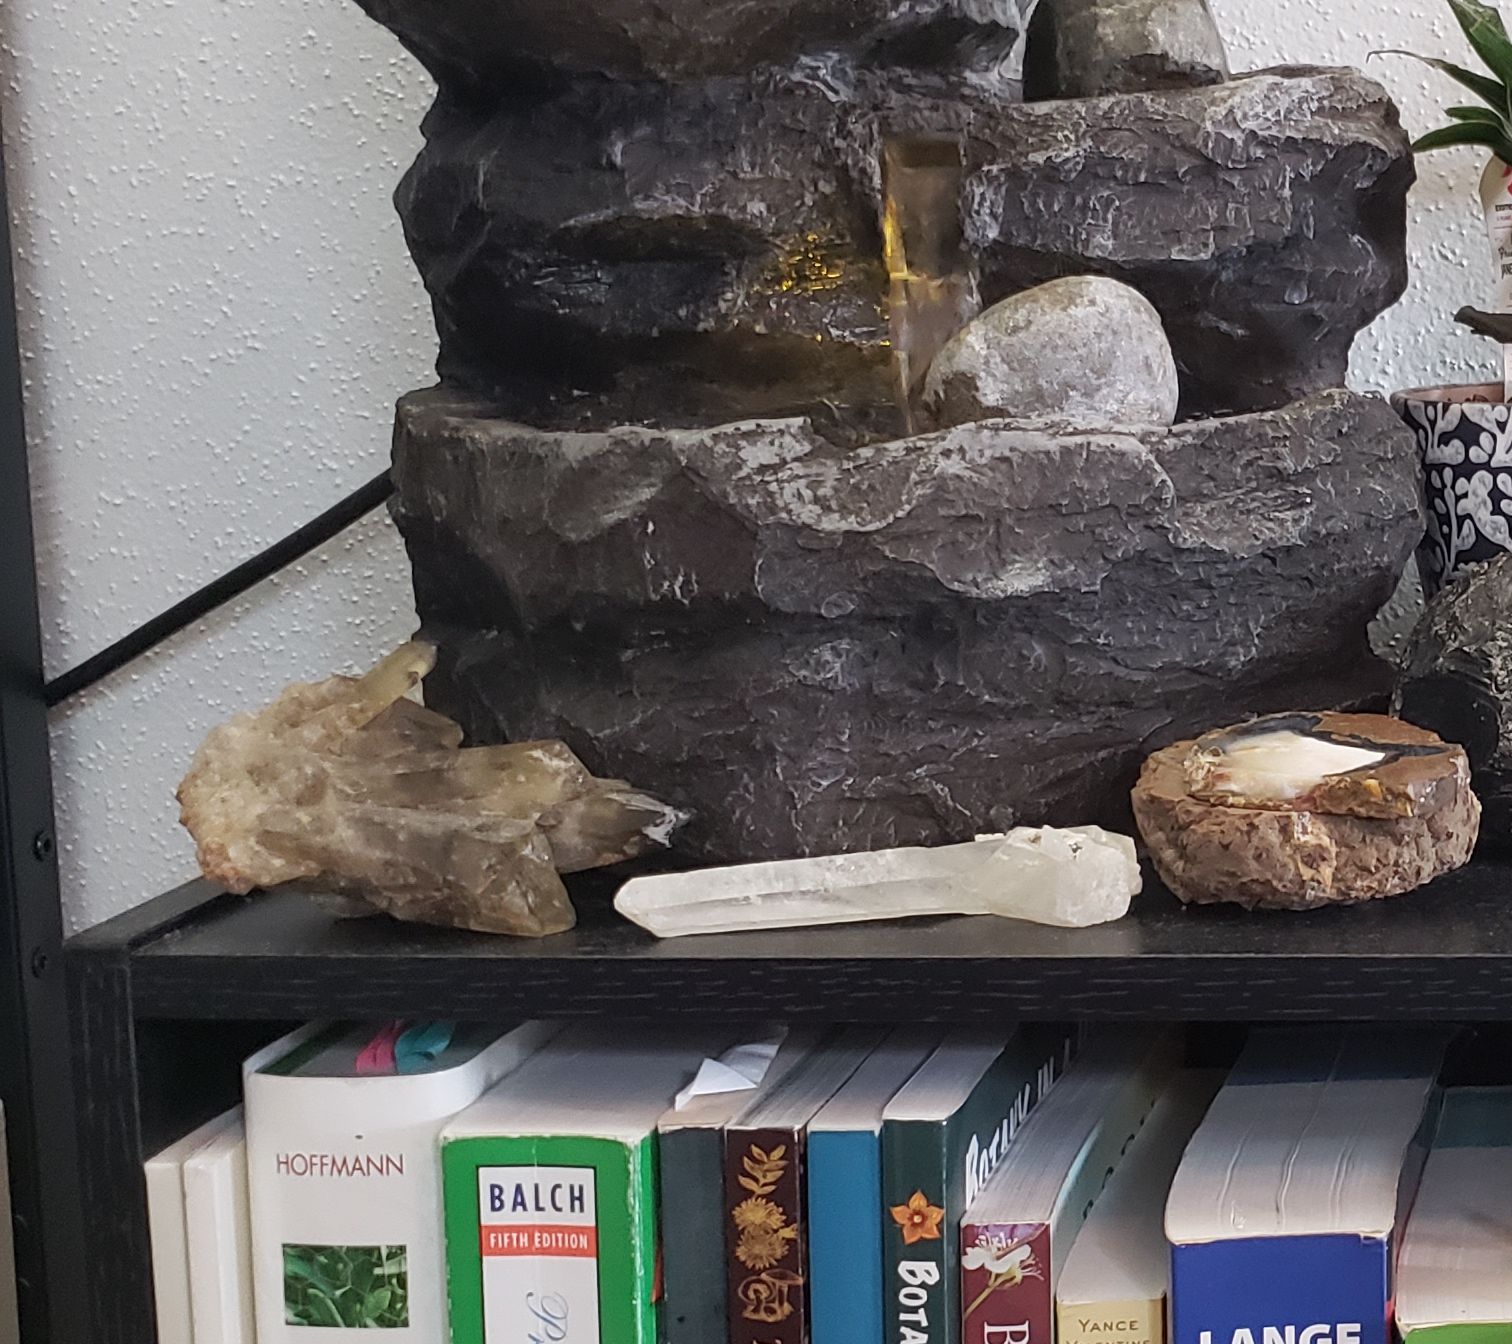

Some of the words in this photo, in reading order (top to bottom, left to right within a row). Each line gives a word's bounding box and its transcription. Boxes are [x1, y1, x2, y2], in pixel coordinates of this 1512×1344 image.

[276, 1153, 404, 1177] HOFFMANN
[490, 1183, 585, 1213] BALCH
[489, 1232, 529, 1249] FIFTH
[534, 1232, 588, 1250] EDITION
[1079, 1319, 1140, 1333] YANCE
